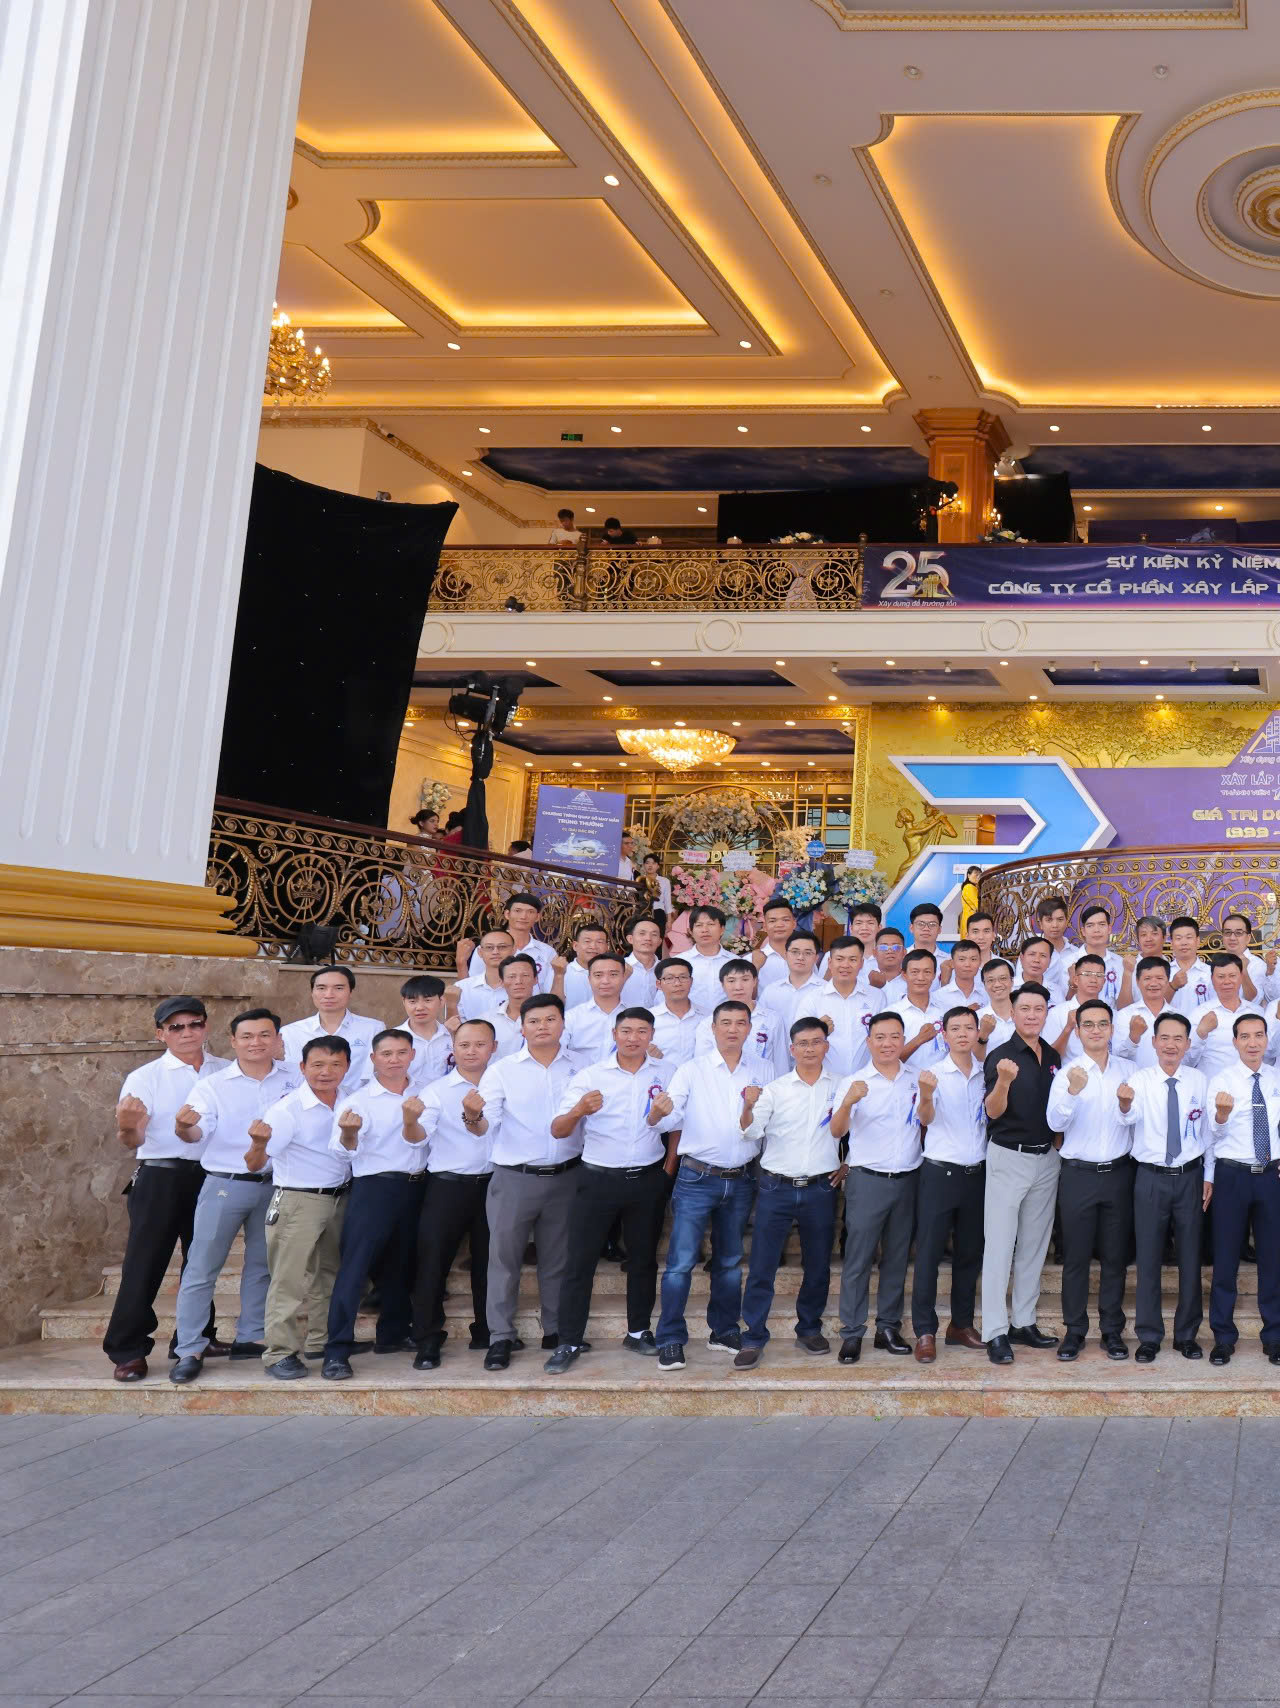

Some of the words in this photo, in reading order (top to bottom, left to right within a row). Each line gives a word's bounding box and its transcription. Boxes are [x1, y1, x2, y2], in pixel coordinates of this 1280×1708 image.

[1106, 556, 1138, 570] SỰ
[1143, 554, 1188, 570] KIỆN
[1197, 554, 1224, 568] KỶ
[1232, 554, 1280, 570] NIỆM
[880, 550, 950, 598] 25
[988, 581, 1042, 594] CÔNG
[1050, 584, 1076, 595] TY
[1085, 578, 1112, 594] CỔ
[1120, 579, 1174, 595] PHẦN
[1181, 580, 1222, 595] XÂY
[1230, 578, 1270, 595] LẮP
[1220, 772, 1248, 786] XÂY
[1251, 770, 1275, 786] LẮP
[1192, 806, 1224, 820] GIÁ
[1226, 810, 1258, 822] TRỊ
[1226, 826, 1270, 838] 1999
